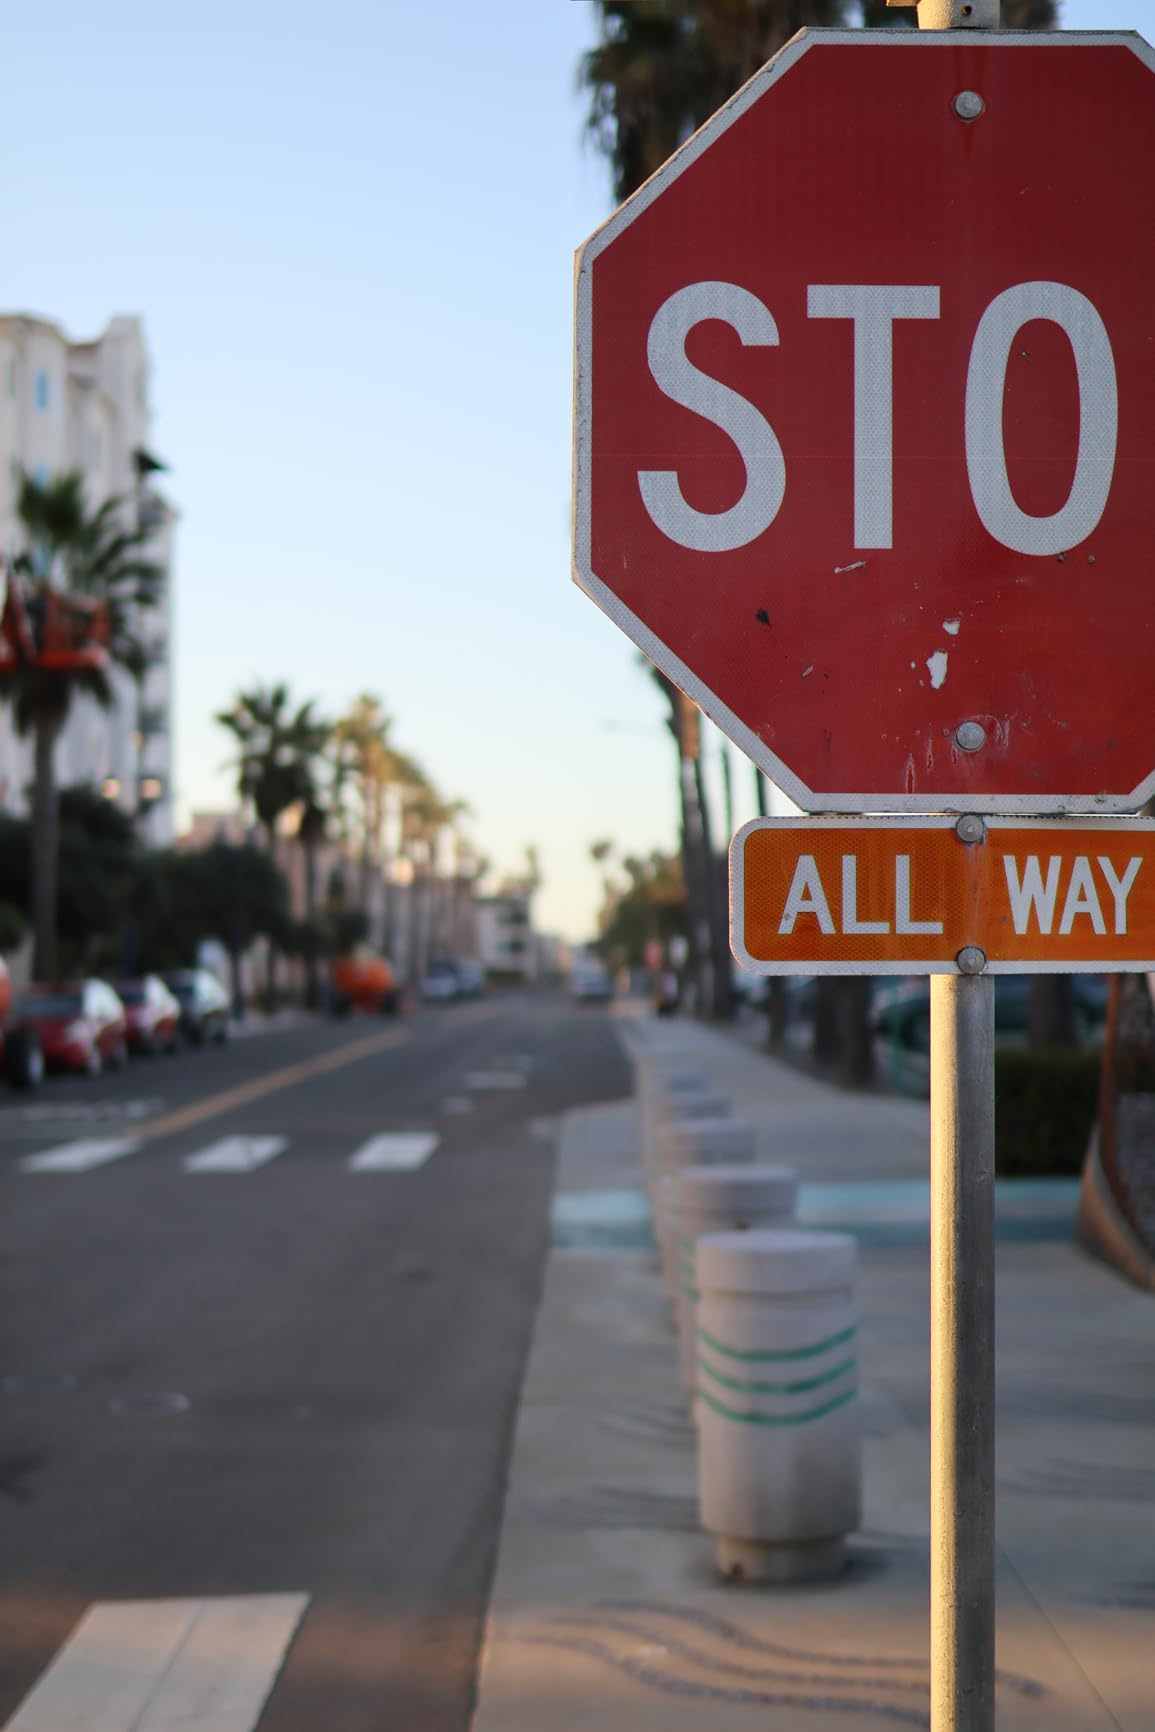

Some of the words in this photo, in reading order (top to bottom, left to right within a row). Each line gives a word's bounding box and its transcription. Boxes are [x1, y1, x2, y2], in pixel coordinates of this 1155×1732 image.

[637, 280, 1118, 556] STO
[777, 854, 944, 935] ALL
[1003, 855, 1143, 936] WAY
